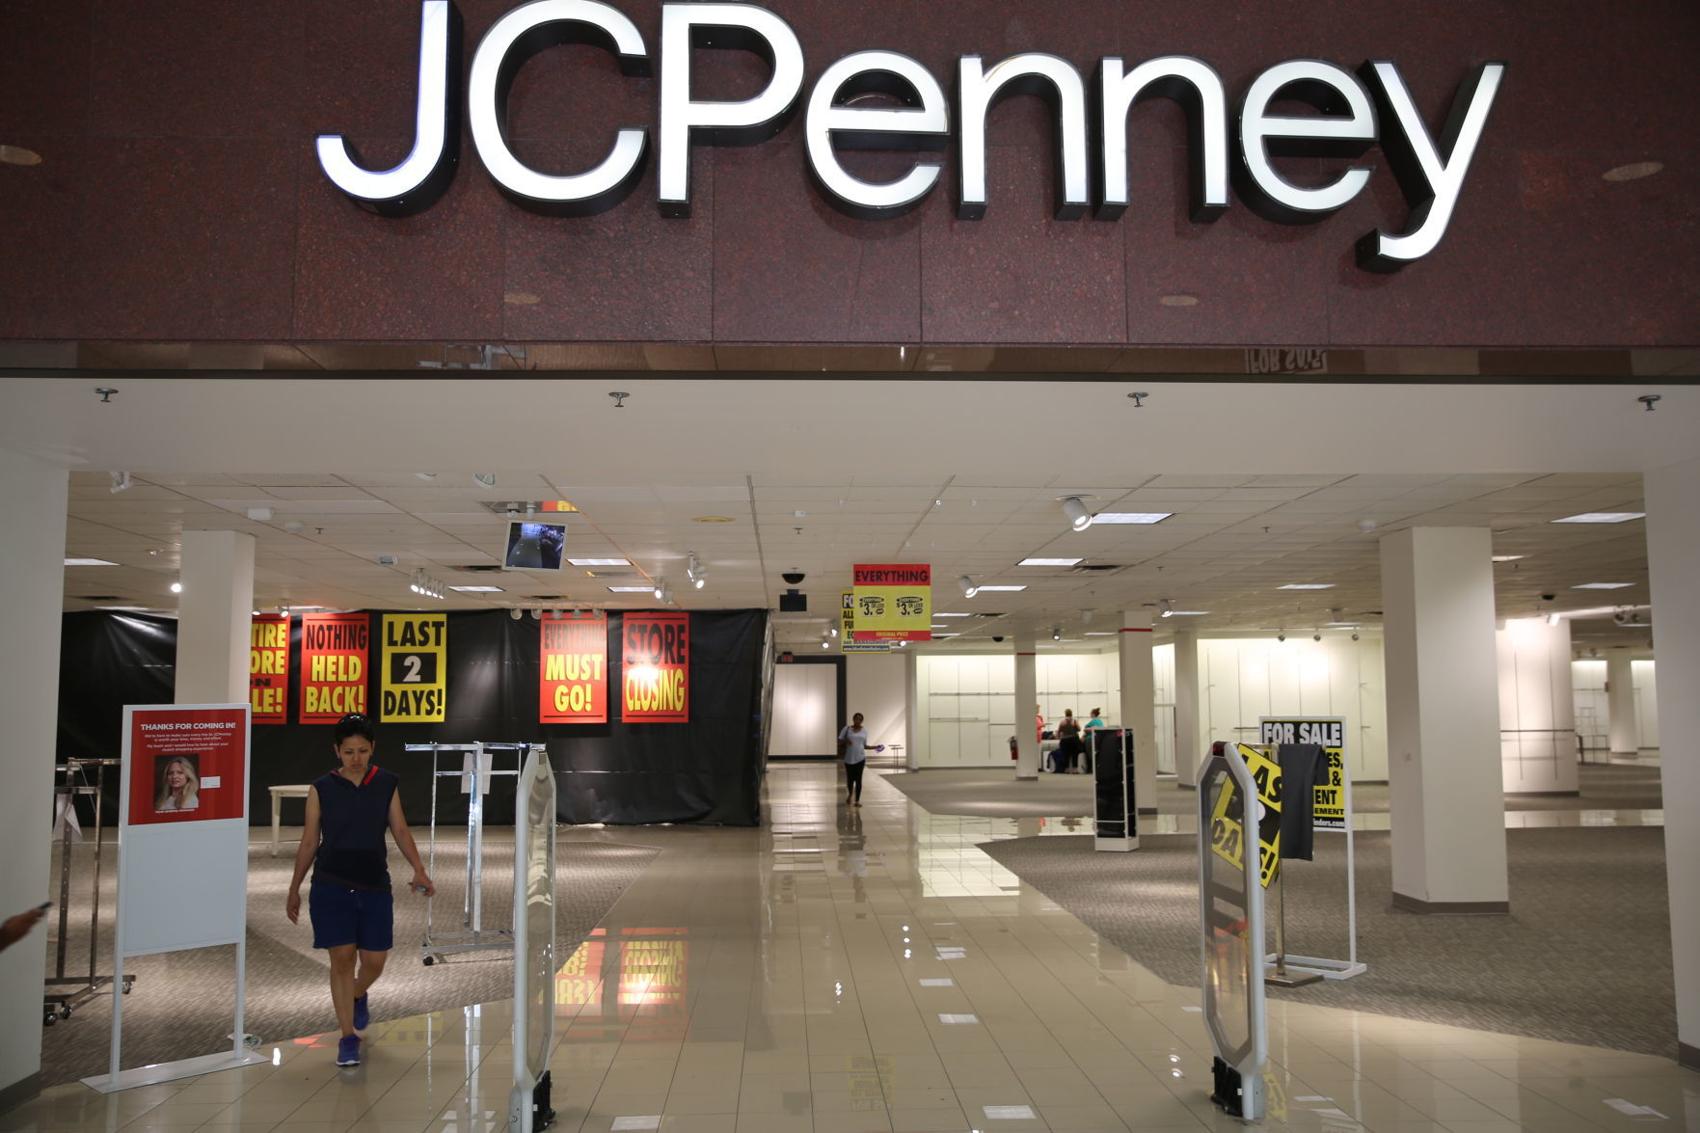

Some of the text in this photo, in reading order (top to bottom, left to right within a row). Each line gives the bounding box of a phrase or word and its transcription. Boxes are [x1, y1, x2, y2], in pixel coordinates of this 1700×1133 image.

[315, 0, 1504, 261] JCPenney
[855, 571, 928, 582] EVERYTHING
[306, 624, 367, 651] NOTHING
[387, 620, 445, 647] LAST
[626, 623, 686, 665] STORE
[311, 655, 362, 682] HELD
[402, 655, 422, 682] 2
[545, 653, 603, 681] MUST
[305, 685, 365, 714] BACK!
[383, 688, 443, 716] DAYS!
[554, 684, 592, 712] GO!
[625, 668, 685, 711] CLOSING
[141, 723, 174, 731] THANKS
[193, 722, 224, 730] COMING
[1263, 722, 1342, 747] FOR SALE
[1332, 771, 1342, 787] &
